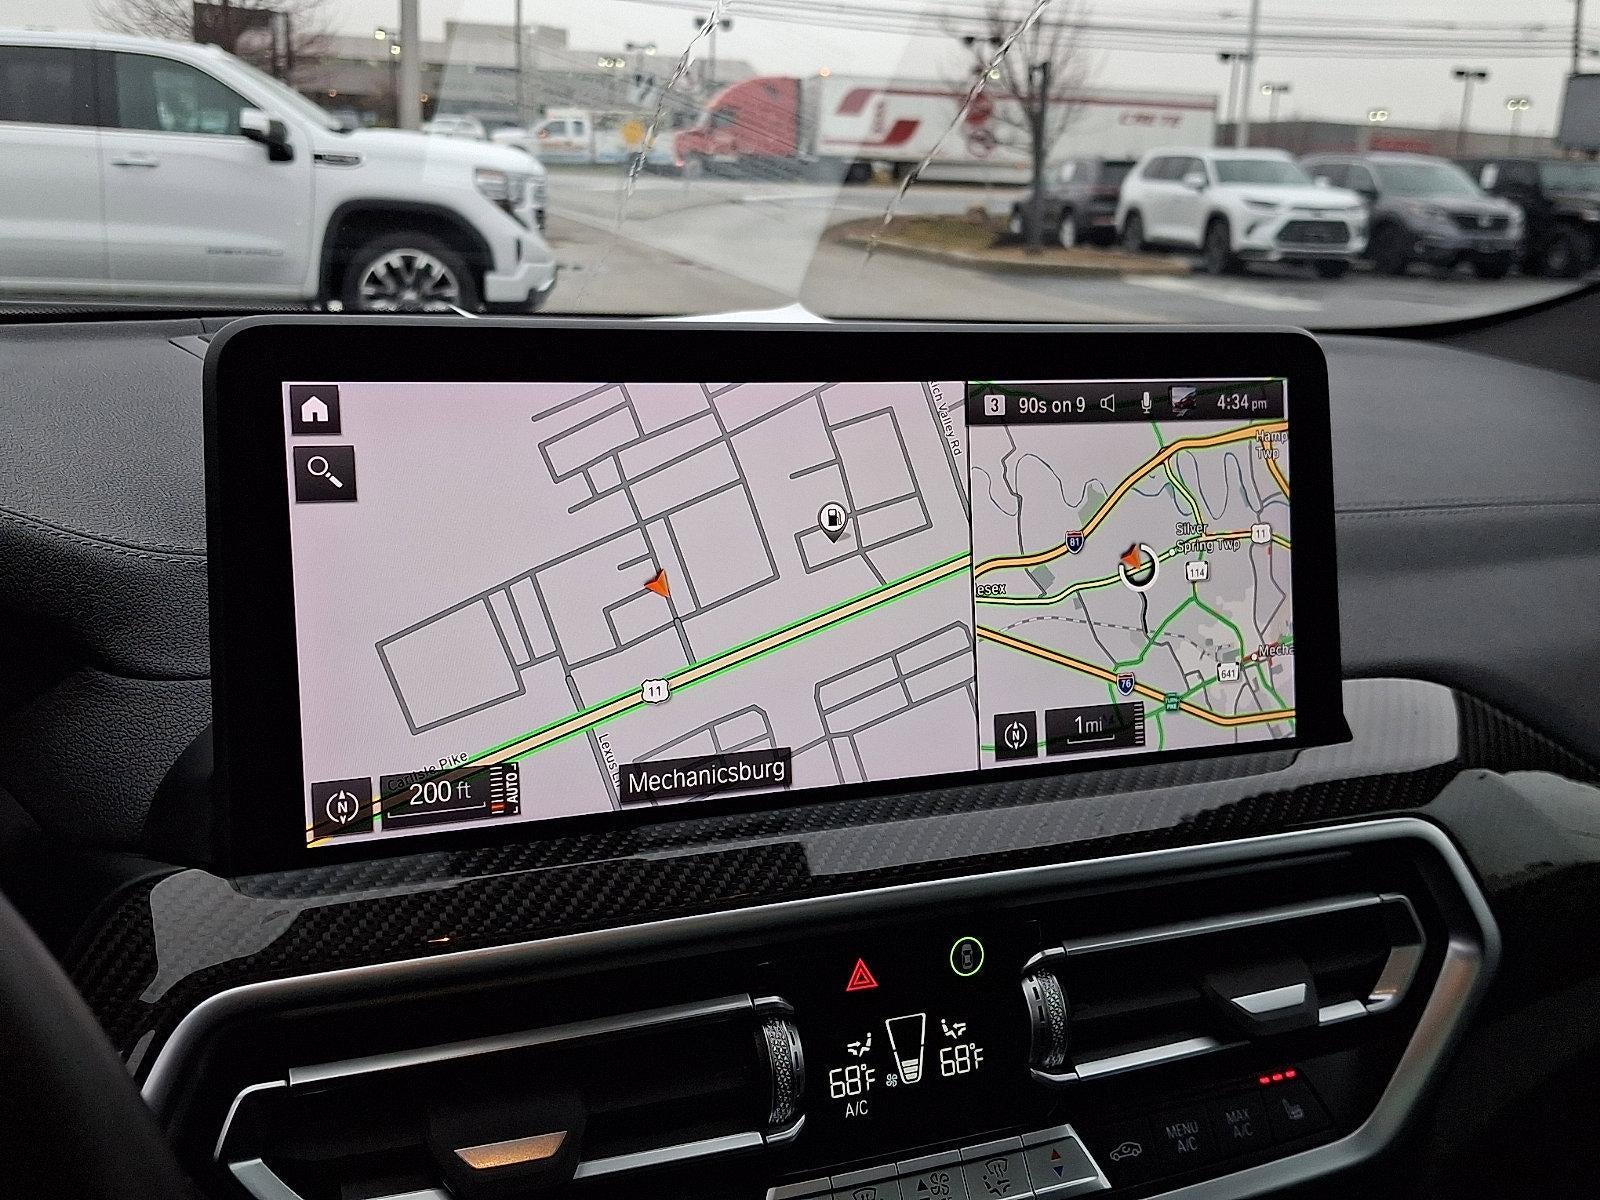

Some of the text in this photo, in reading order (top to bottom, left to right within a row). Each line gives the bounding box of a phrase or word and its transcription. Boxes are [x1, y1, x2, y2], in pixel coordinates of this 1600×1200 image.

[990, 397, 999, 413] 3
[1019, 396, 1086, 414] 90s on 9
[1217, 393, 1267, 412] 4:34 pm
[939, 402, 955, 438] Valley
[950, 439, 962, 456] Rd
[1255, 429, 1288, 445] Hamp
[1255, 446, 1280, 461] Twp
[1175, 521, 1209, 535] Silver
[1255, 528, 1266, 539] 11
[1070, 537, 1080, 547] 81
[1175, 537, 1241, 554] Spring Twp
[1190, 567, 1205, 578] 114
[975, 582, 1007, 596] esex
[1220, 668, 1236, 679] 641
[648, 685, 662, 697] 11
[1121, 678, 1132, 689] 76
[598, 733, 618, 771] Lexus
[387, 751, 468, 792] Carlisle Pike
[628, 760, 786, 794] Mechanicsburg
[409, 780, 472, 806] 200 ft
[506, 772, 519, 804] AUTO
[845, 1100, 869, 1118] A/C
[1225, 1108, 1251, 1124] MAX
[1165, 1121, 1199, 1138] MENU
[1233, 1122, 1254, 1138] A/C
[1177, 1136, 1198, 1153] A/C
